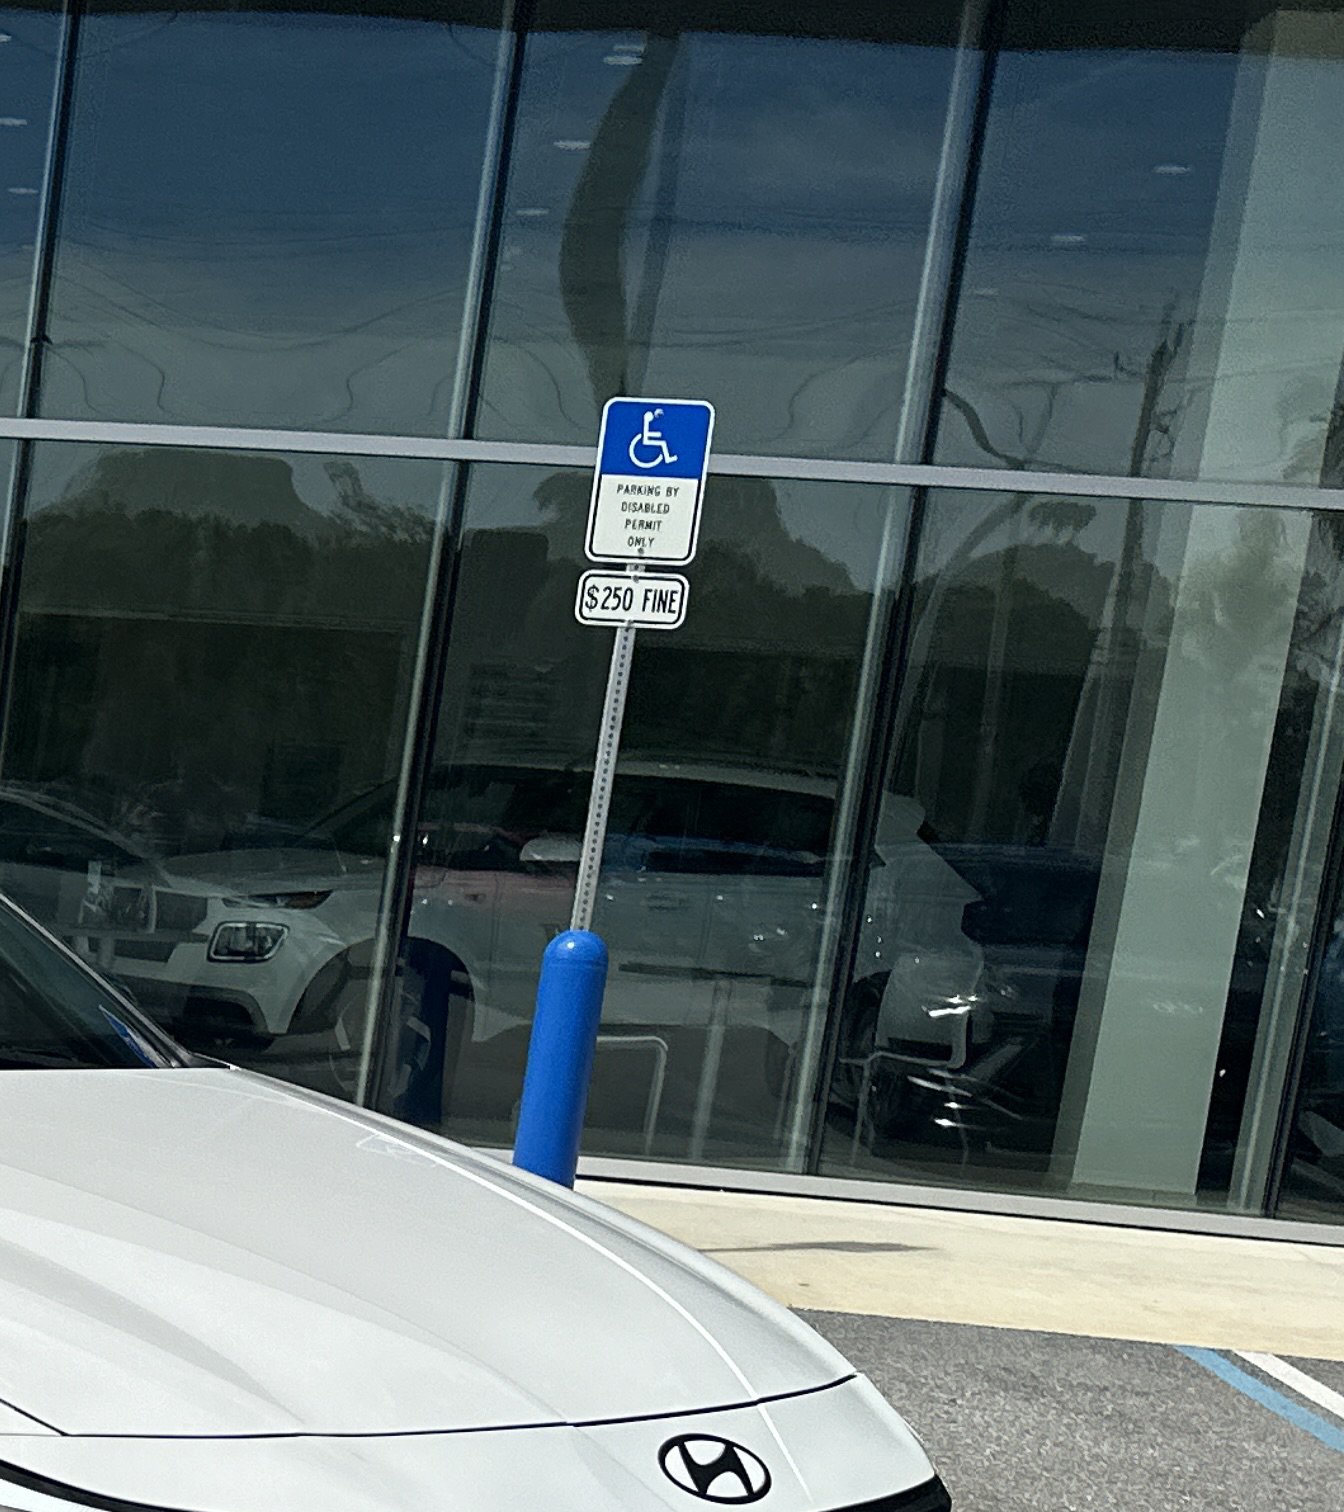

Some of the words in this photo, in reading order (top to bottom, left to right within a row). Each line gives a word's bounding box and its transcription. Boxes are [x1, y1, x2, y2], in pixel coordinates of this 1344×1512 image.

[616, 484, 661, 497] PARKING
[665, 486, 680, 497] BY
[621, 502, 670, 514] DISABLED
[624, 519, 663, 531] PERMIT
[627, 536, 655, 547] ONLY
[585, 584, 634, 612] $250
[641, 588, 679, 614] FINE
